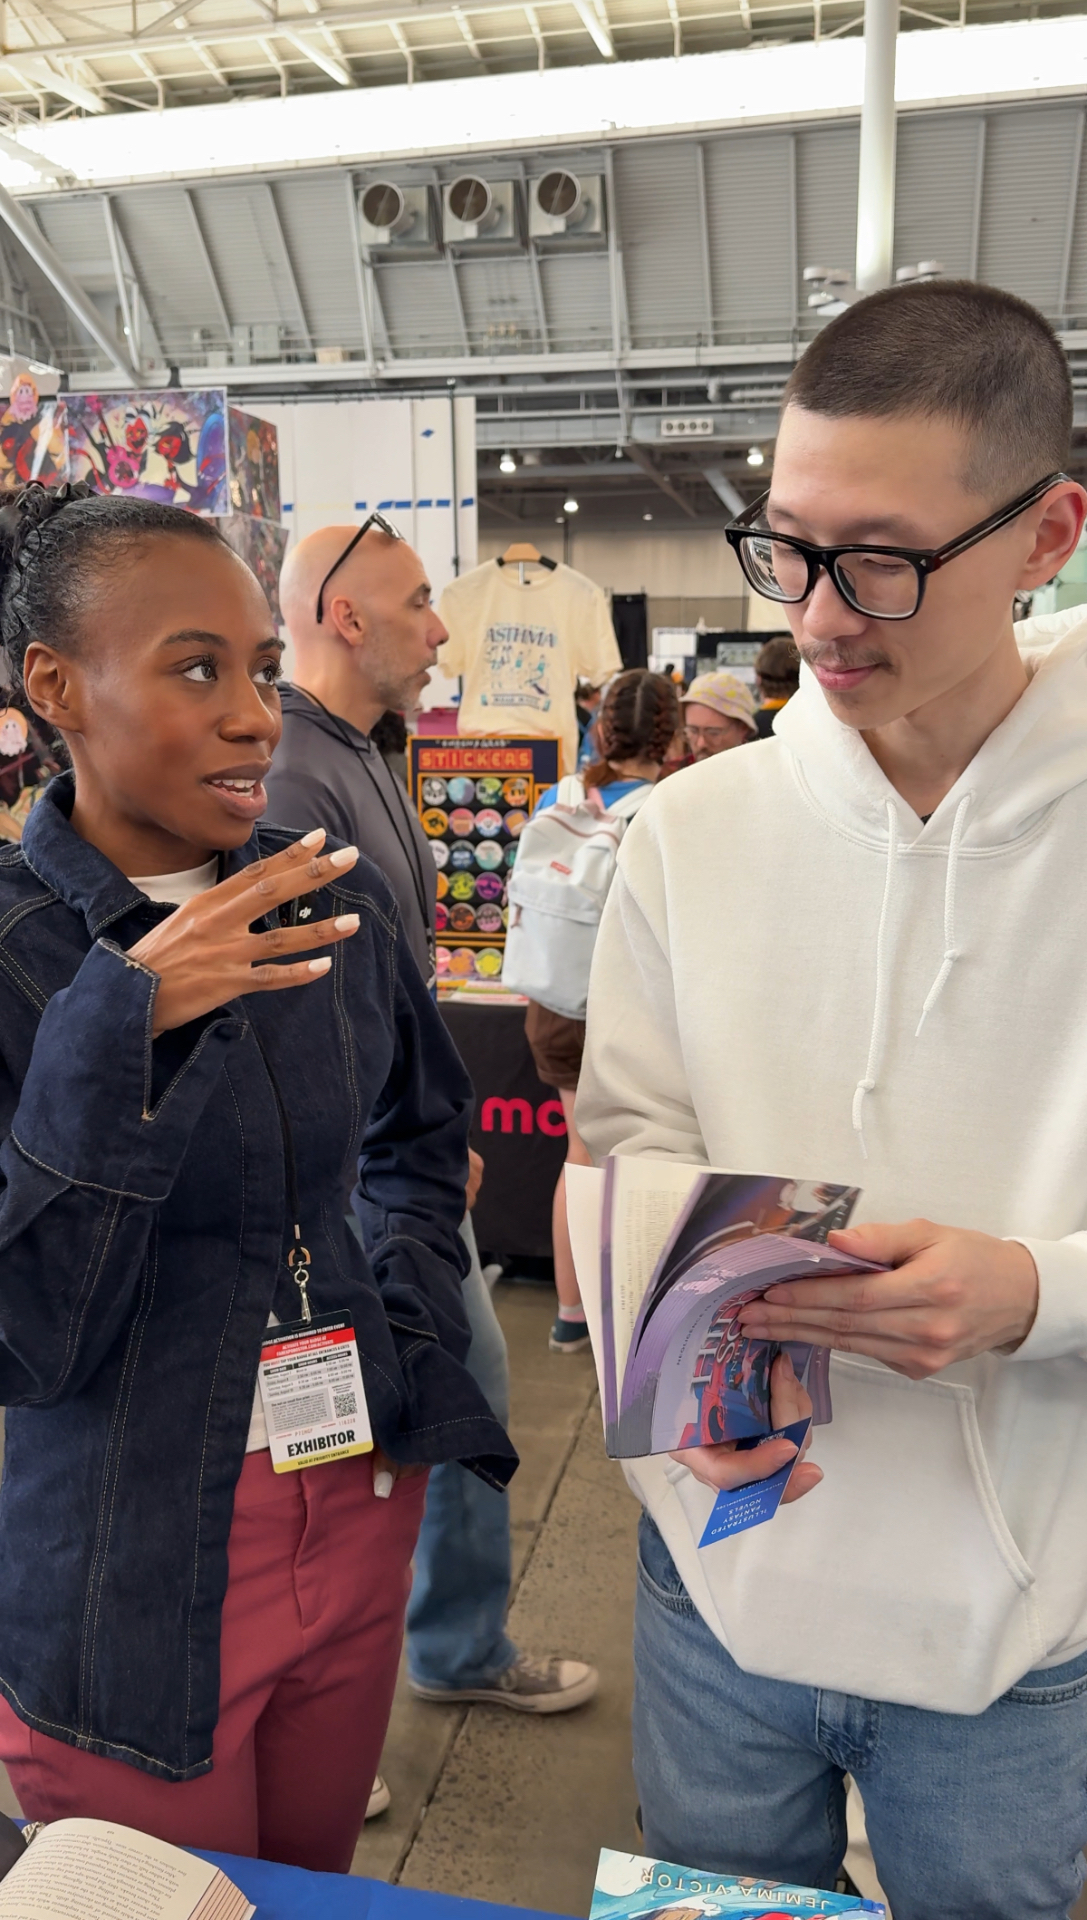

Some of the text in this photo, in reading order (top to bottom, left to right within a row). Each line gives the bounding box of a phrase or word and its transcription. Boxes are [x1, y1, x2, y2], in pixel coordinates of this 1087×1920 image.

[421, 752, 530, 767] STICKERS
[287, 1429, 356, 1458] EXHIBITOR
[723, 1505, 761, 1524] FANTASY
[728, 1498, 762, 1515] NOVELS
[711, 1508, 767, 1535] ILLUSTRATED
[641, 1868, 830, 1910] JEMIMA VICTOR
